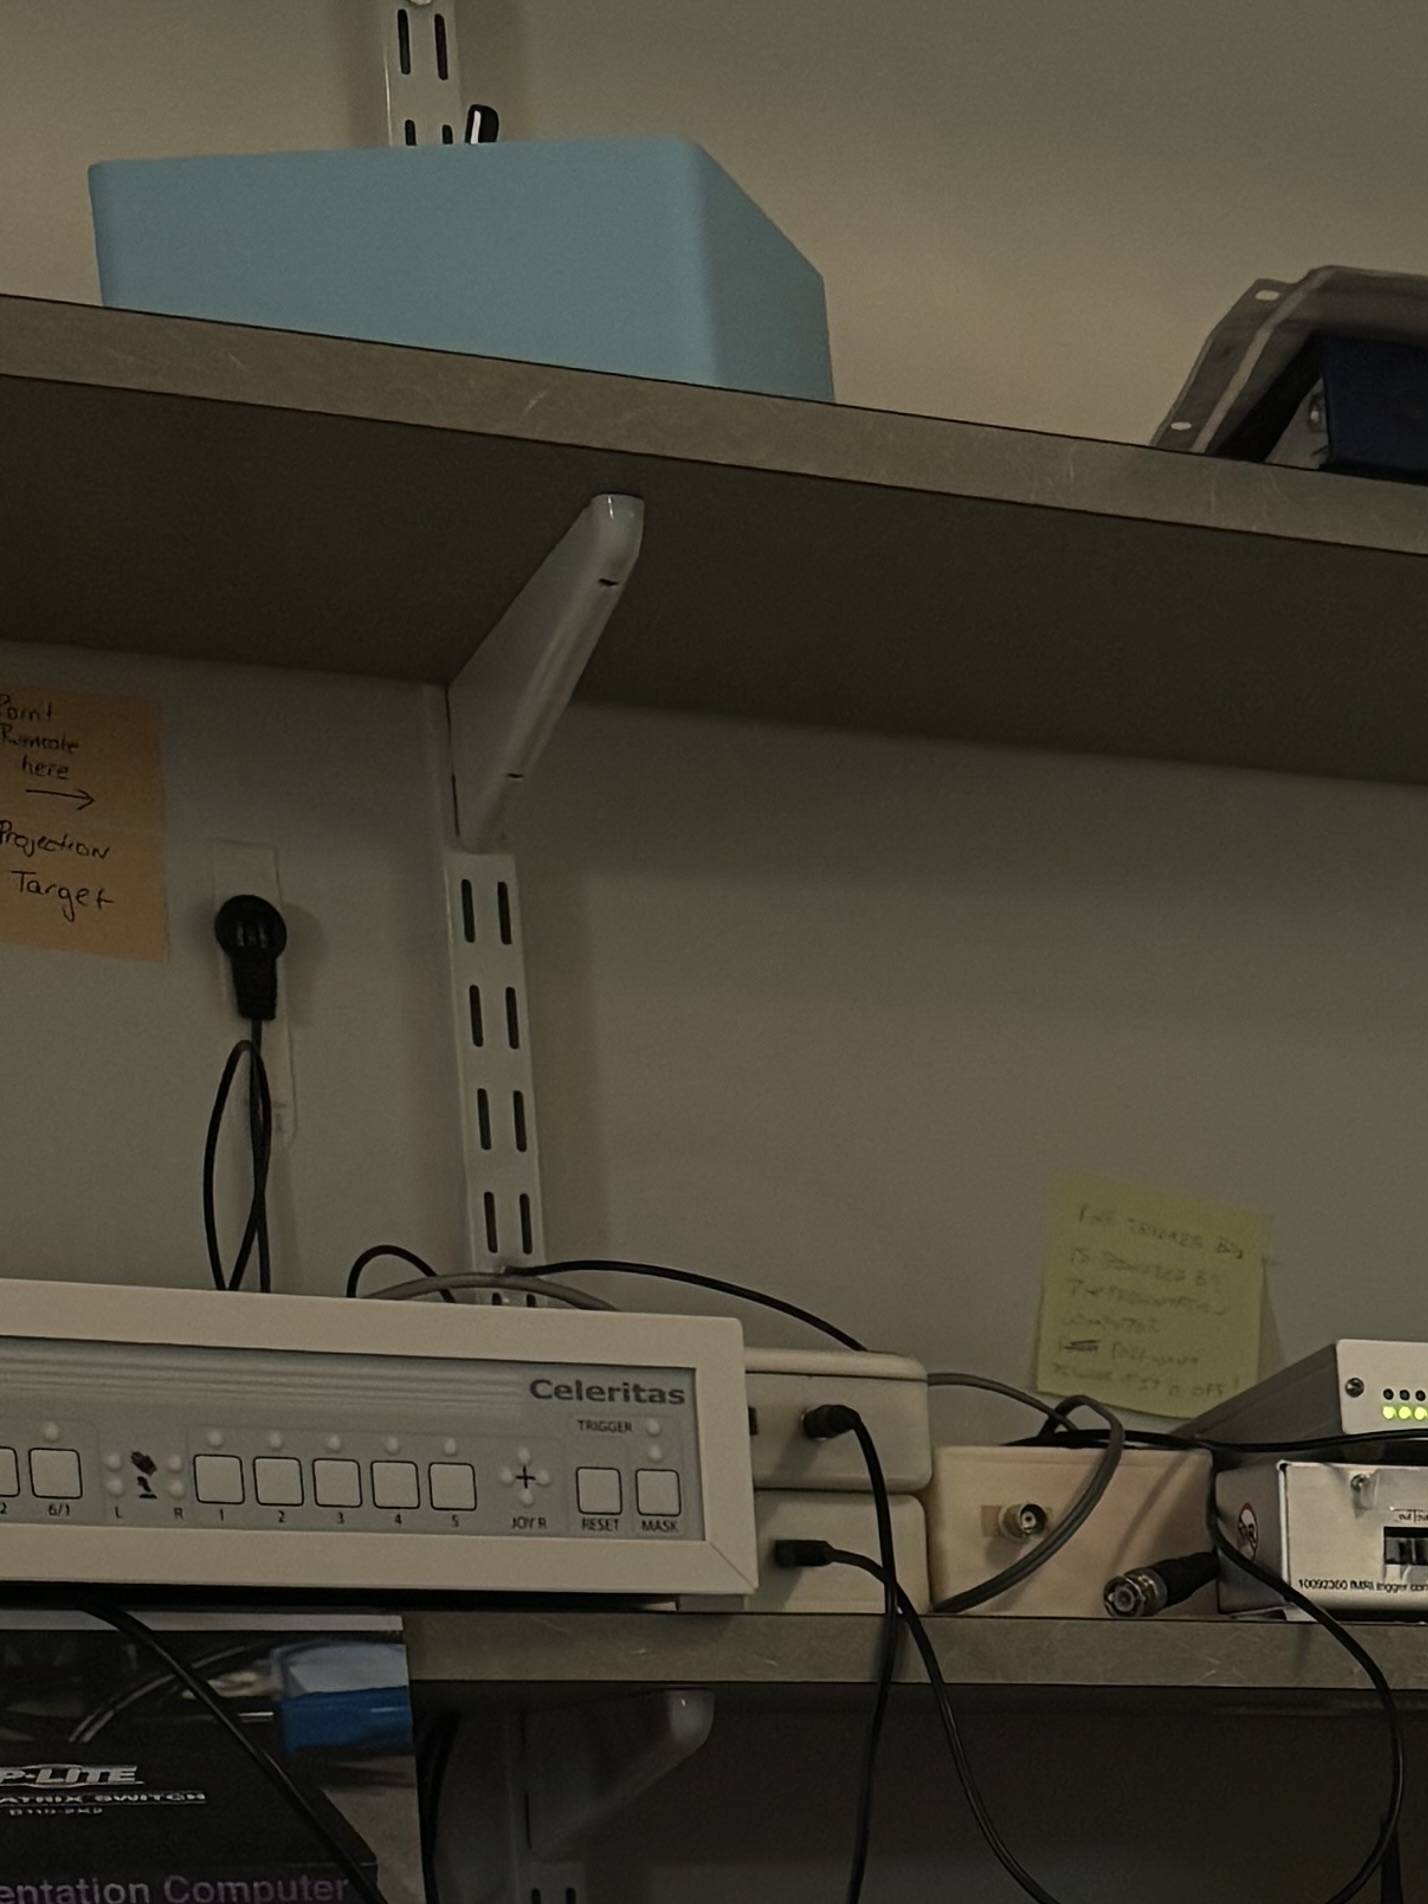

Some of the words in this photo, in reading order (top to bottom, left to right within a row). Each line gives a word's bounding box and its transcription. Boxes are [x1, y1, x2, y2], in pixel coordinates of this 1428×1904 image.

[23, 755, 70, 780] here
[0, 820, 110, 860] Projection
[11, 870, 115, 923] Target
[530, 1379, 685, 1405] Celeritas
[577, 1420, 632, 1433] TRIGGER
[115, 1506, 122, 1518] L
[174, 1508, 183, 1519] R
[278, 1511, 285, 1523] 2
[337, 1512, 344, 1524] 3
[394, 1514, 402, 1525] 4
[452, 1515, 459, 1527] 5
[538, 1517, 547, 1528] R
[582, 1519, 619, 1531] RESET
[642, 1520, 679, 1533] MASK
